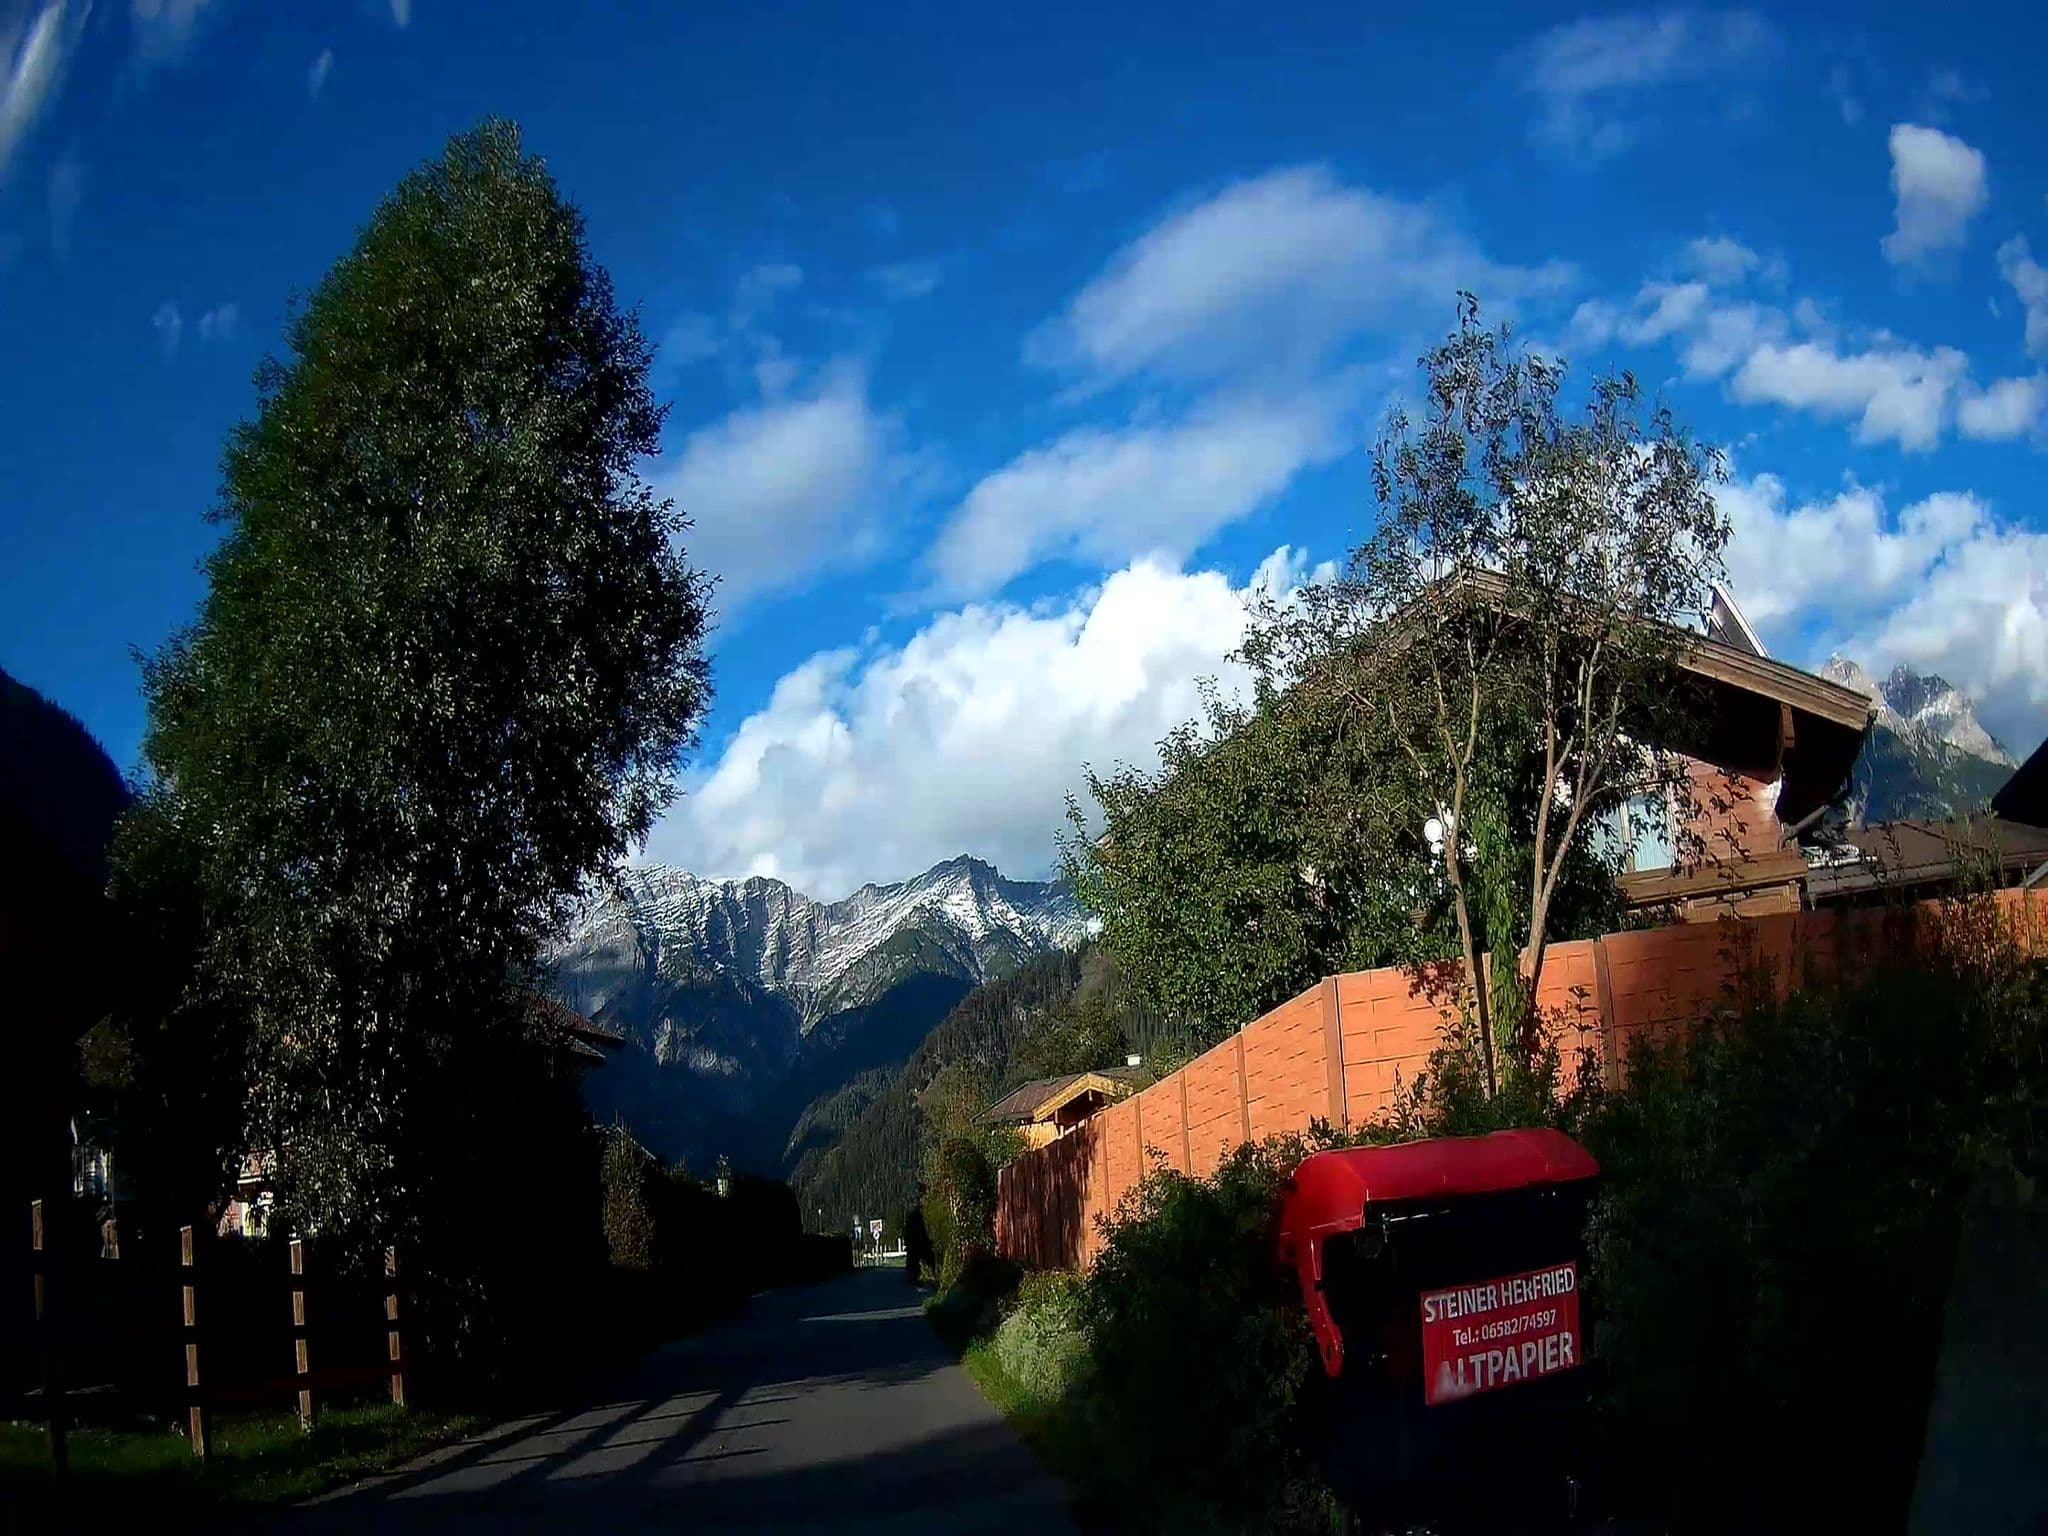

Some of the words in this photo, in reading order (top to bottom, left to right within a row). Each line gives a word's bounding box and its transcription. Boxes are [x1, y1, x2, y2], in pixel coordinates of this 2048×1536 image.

[1424, 1285, 1498, 1323] STEINER
[1453, 1326, 1480, 1346] Tel.:
[1481, 1309, 1557, 1340] 06582/74597
[1437, 1331, 1574, 1391] ALTPAPIER
